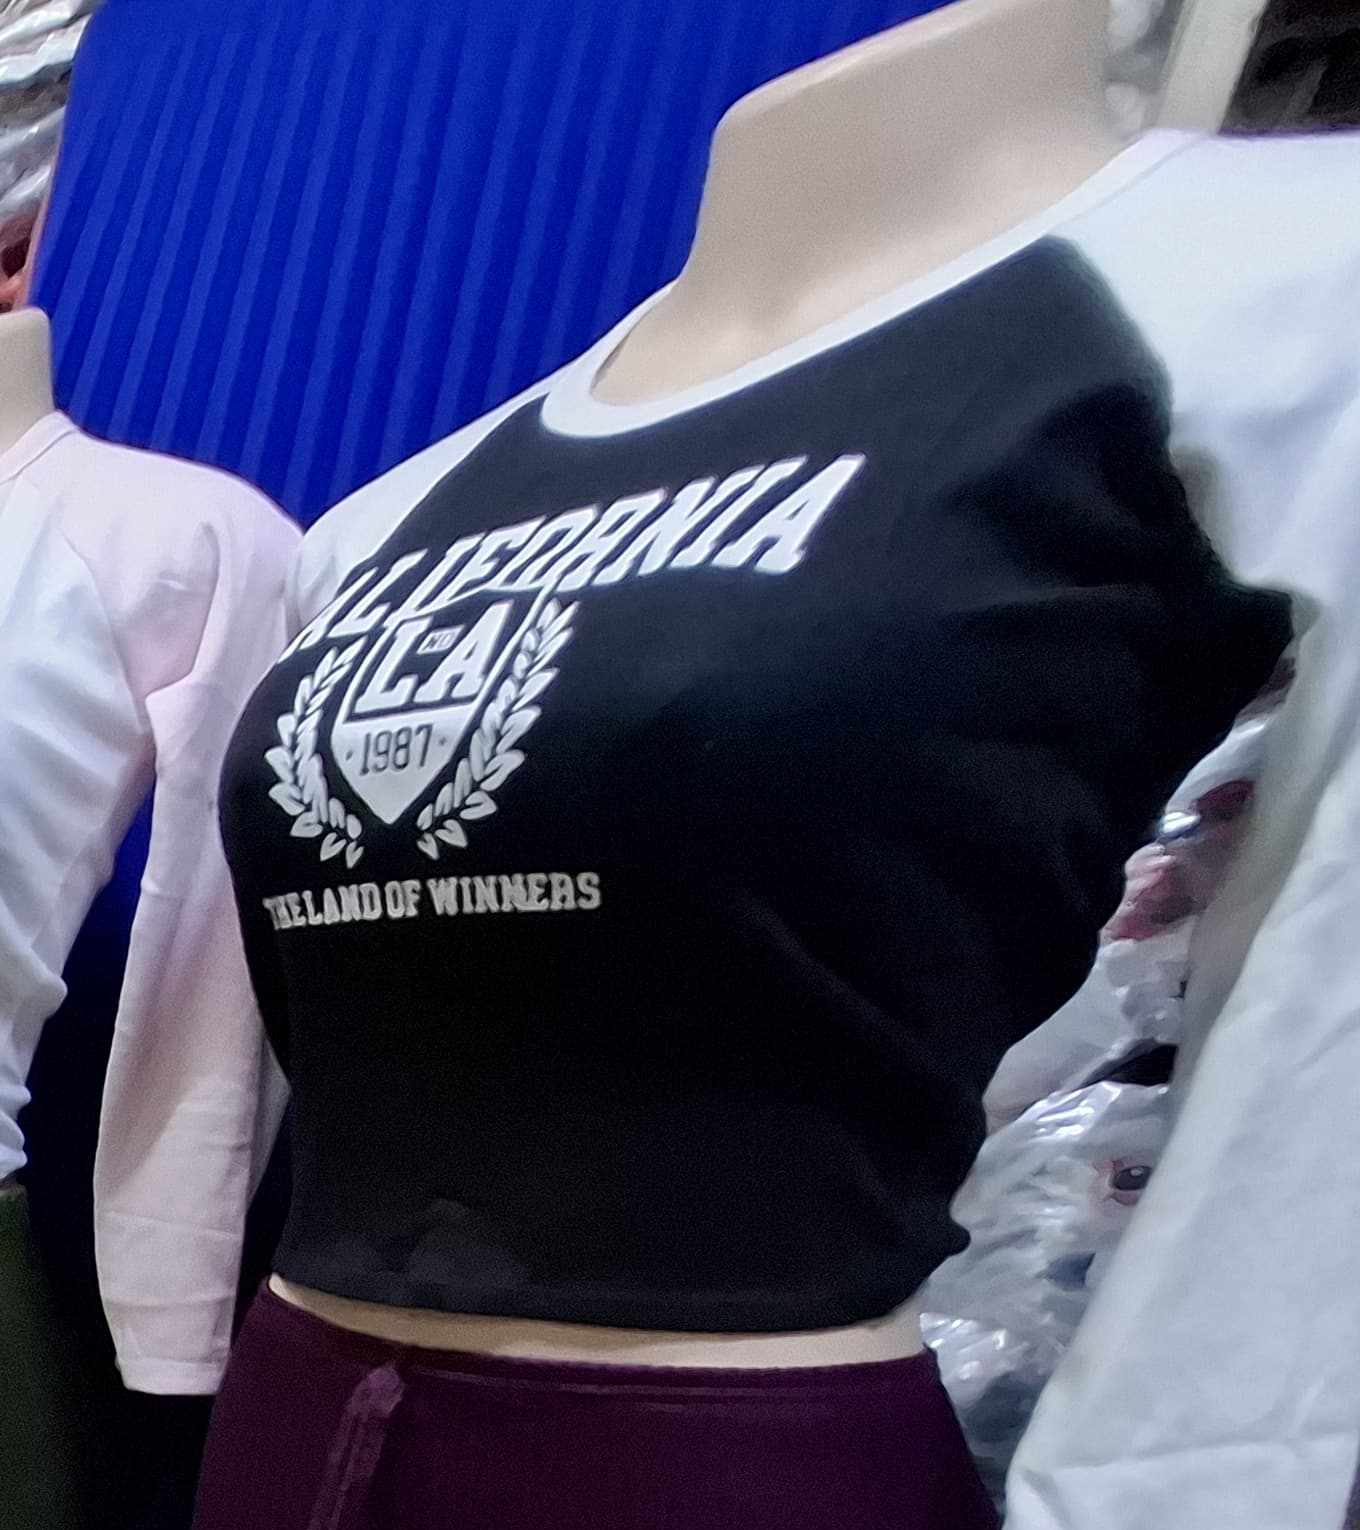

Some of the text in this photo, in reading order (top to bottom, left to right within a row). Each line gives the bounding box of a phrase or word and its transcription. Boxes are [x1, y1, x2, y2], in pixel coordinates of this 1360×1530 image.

[279, 454, 866, 663] ALIFORNIA
[359, 723, 434, 777] 1987
[302, 882, 382, 926] LAND
[384, 879, 421, 918] OF
[426, 871, 603, 916] WINNERS
